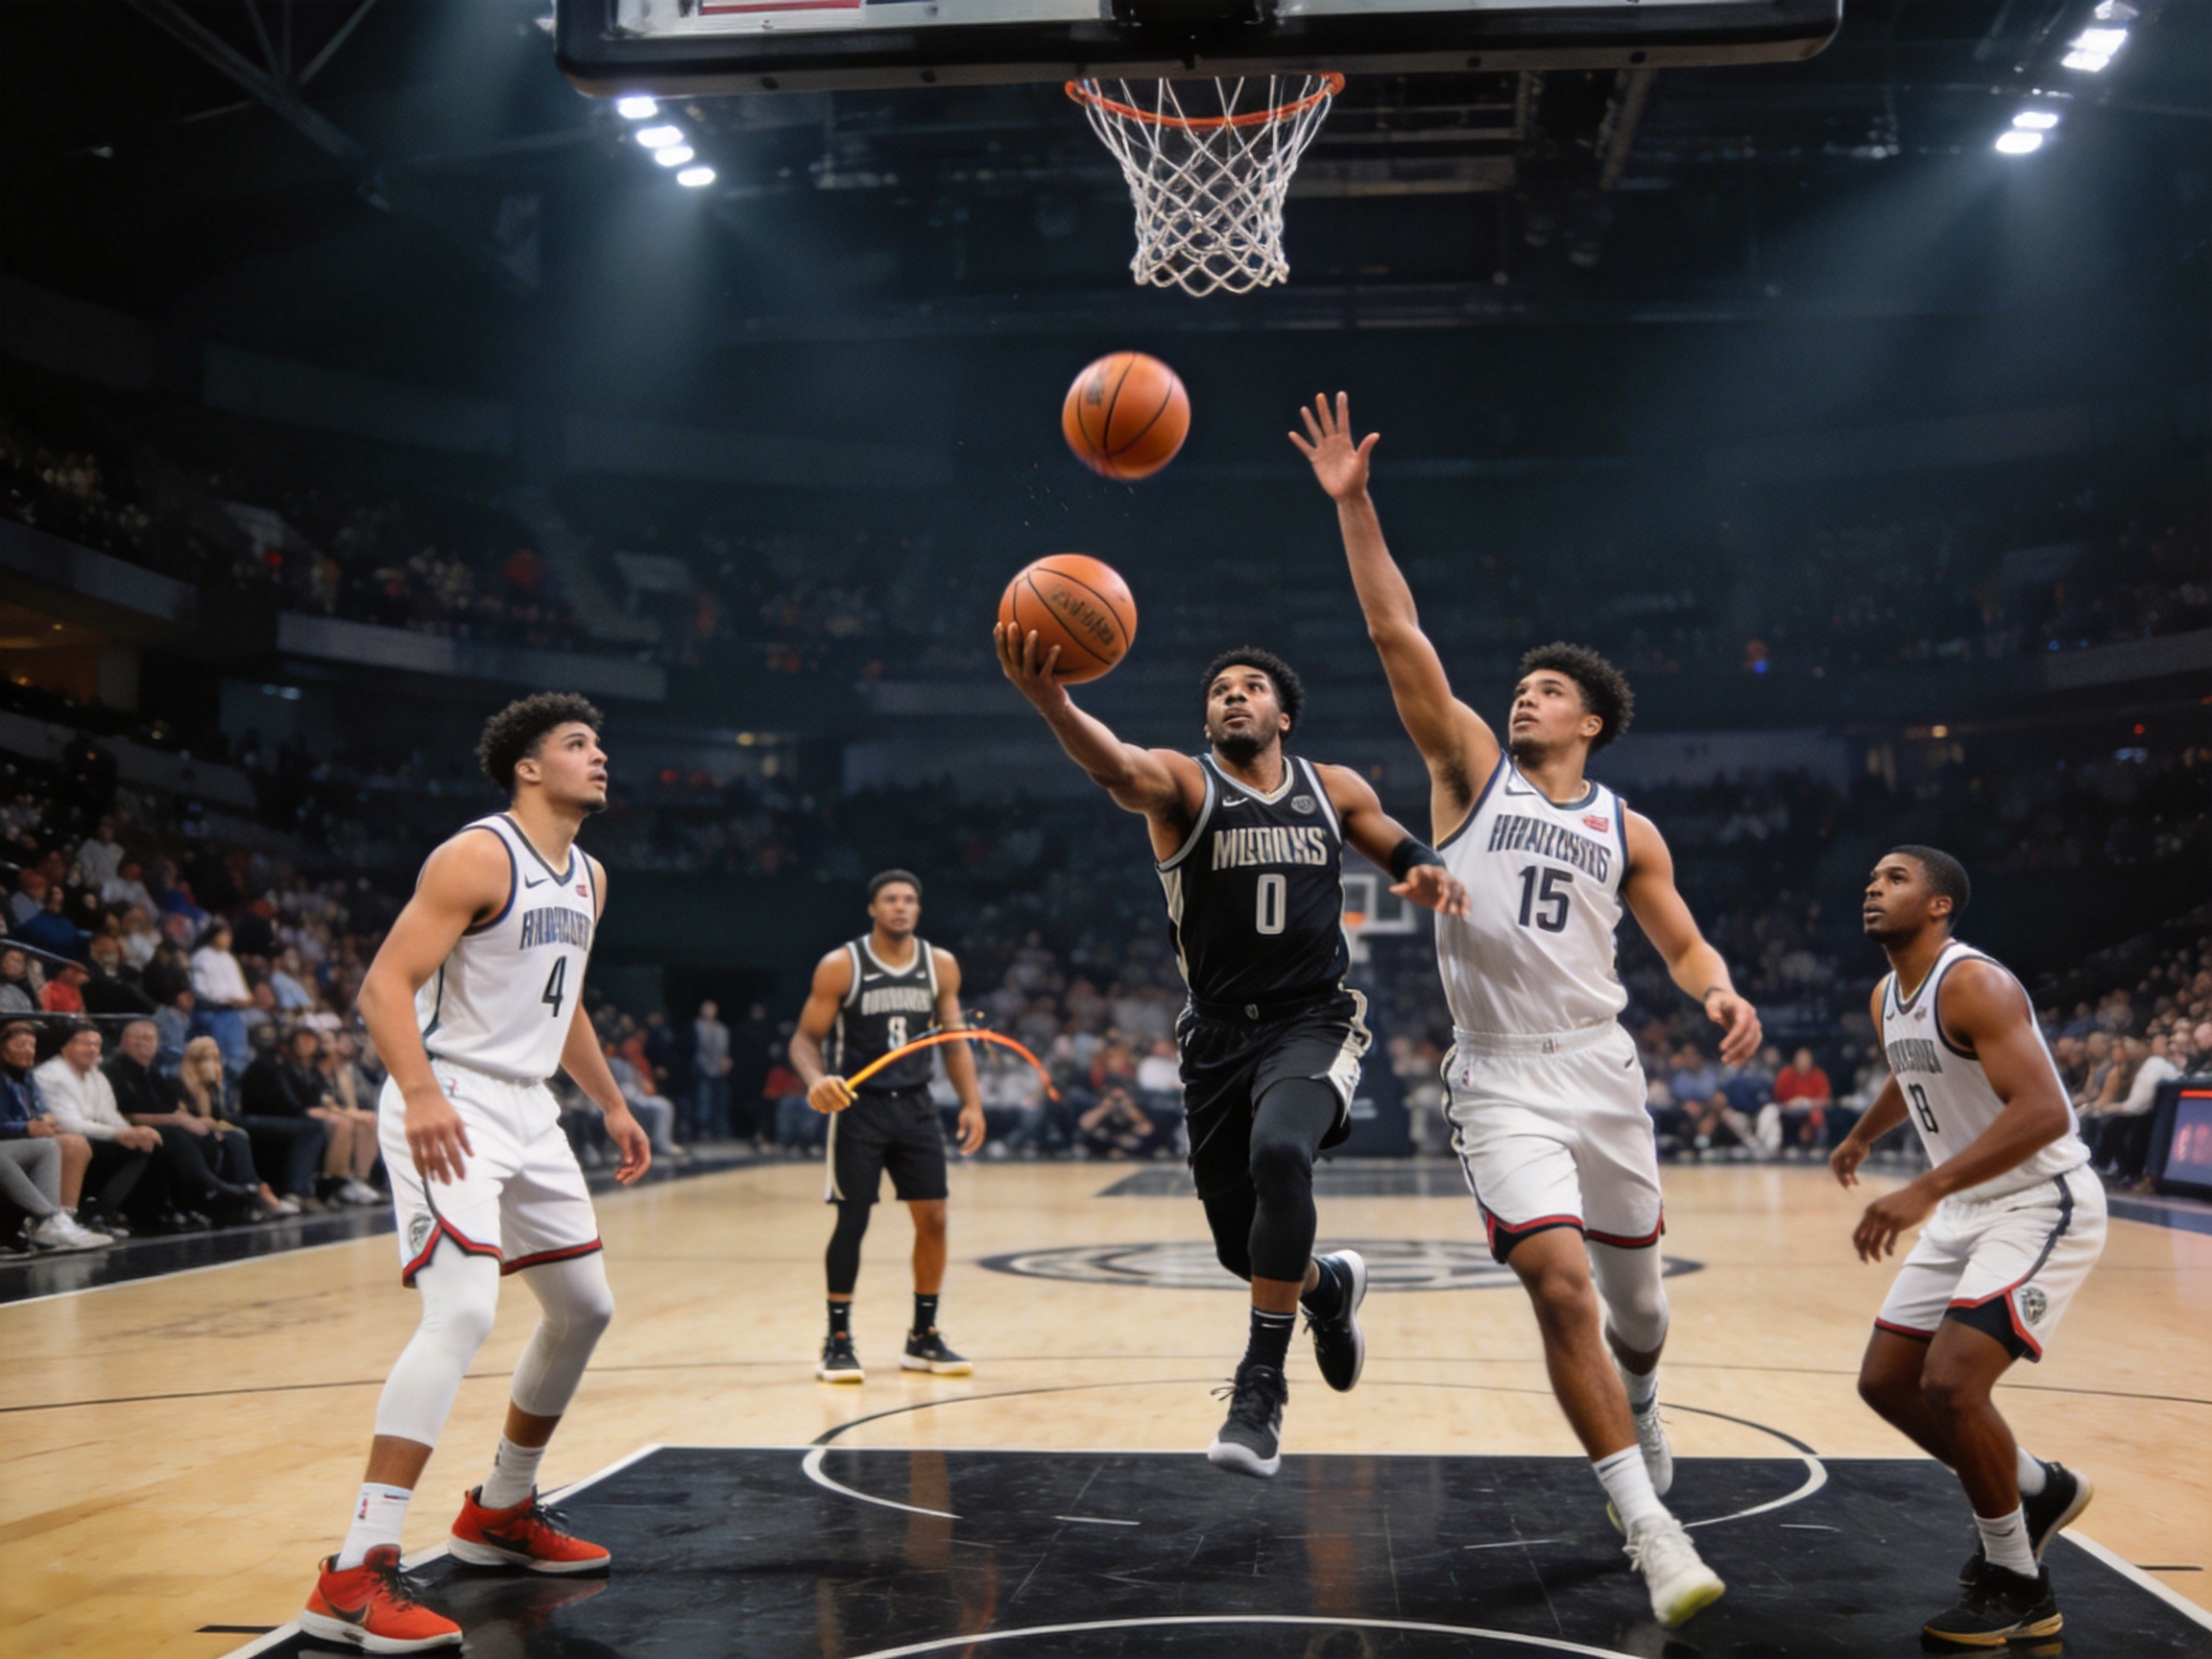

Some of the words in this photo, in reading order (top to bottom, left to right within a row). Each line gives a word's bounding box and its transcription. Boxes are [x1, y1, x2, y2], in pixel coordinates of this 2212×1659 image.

[1256, 874, 1286, 934] 0
[1518, 865, 1573, 933] 15
[541, 955, 566, 1018] 4
